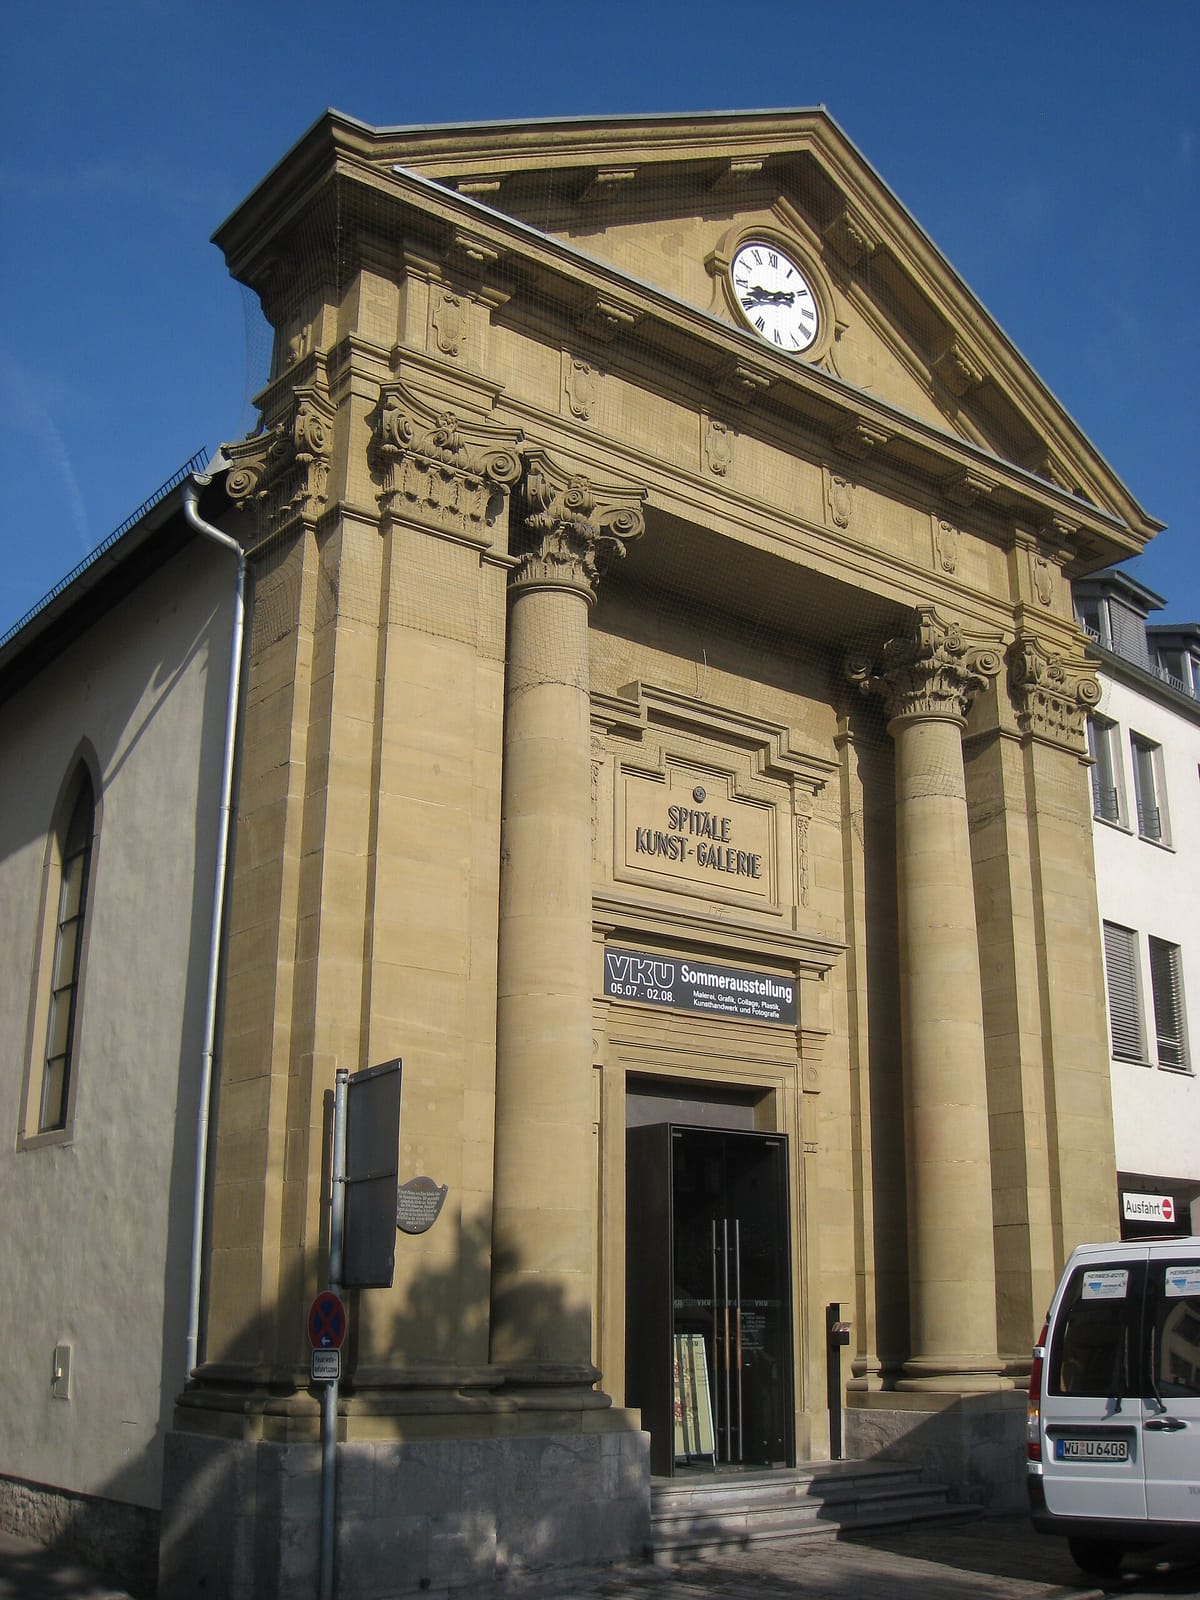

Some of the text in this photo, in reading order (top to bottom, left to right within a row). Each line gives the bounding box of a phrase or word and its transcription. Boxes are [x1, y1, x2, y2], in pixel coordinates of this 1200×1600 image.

[768, 252, 778, 269] XII
[668, 805, 732, 843] SPITÄLE
[636, 827, 762, 879] KUNST-GALERIE
[606, 953, 675, 989] VKU
[680, 964, 793, 1004] Sommerausstellung
[646, 988, 676, 1002] 02.08.
[693, 990, 781, 1011] Malerei, Grafik, Collage, Plastik,
[693, 998, 738, 1012] Kunsthandwerk
[752, 1008, 780, 1019] Fotografie
[1126, 1199, 1160, 1215] Ausfahrt
[1064, 1442, 1126, 1456] WÜ U 6408
